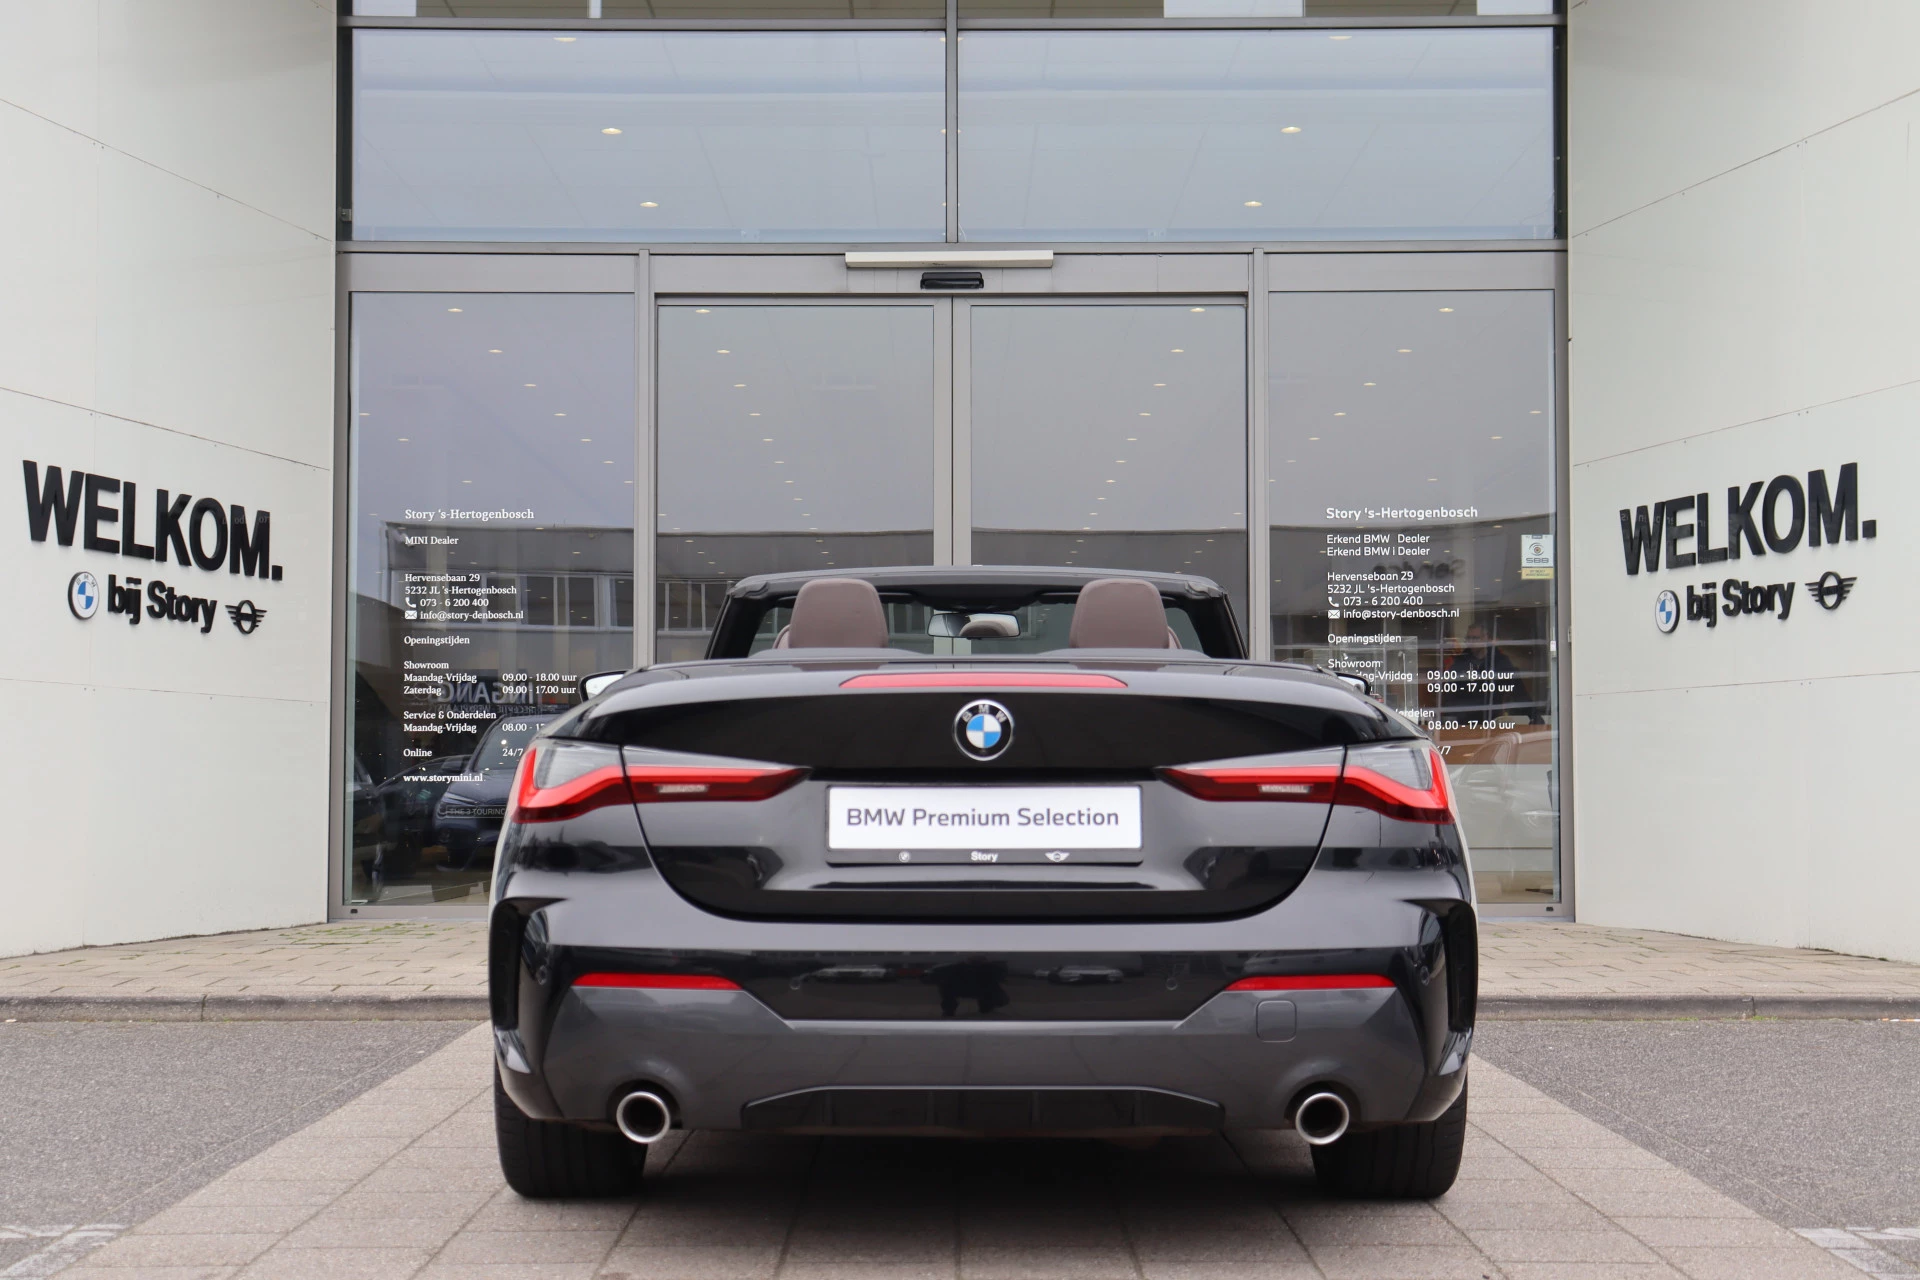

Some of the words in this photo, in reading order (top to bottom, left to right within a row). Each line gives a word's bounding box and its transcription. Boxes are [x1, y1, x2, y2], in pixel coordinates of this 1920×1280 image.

[405, 509, 435, 522] Story
[1326, 507, 1362, 521] Story
[1619, 462, 1877, 576] WELKOM.
[23, 460, 283, 581] WELKOM.
[405, 536, 428, 545] MINI
[430, 536, 459, 545] Dealer
[1327, 534, 1361, 544] Erkend
[1363, 534, 1390, 543] BMW
[1397, 534, 1430, 543] Dealer
[1327, 547, 1361, 556] Erkend
[1363, 547, 1391, 556] BMW
[1398, 547, 1430, 556] Dealer
[405, 573, 466, 582] Hervensebaan
[468, 573, 480, 582] 29
[1327, 572, 1399, 582] Hervensebaan
[1400, 571, 1414, 581] 29
[405, 586, 427, 595] 5232
[429, 586, 440, 596] JL
[1327, 584, 1352, 594] 5232
[1354, 584, 1365, 594] JL
[108, 574, 142, 625] bij
[147, 580, 217, 633] Story
[420, 598, 437, 607] 073
[445, 598, 451, 607] 6
[453, 598, 470, 607] 200
[472, 598, 489, 607] 400
[1343, 597, 1362, 606] 073
[1371, 597, 1378, 606] 6
[1380, 596, 1400, 606] 200
[1402, 596, 1423, 606] 400
[1686, 582, 1717, 627] bij
[1721, 579, 1795, 620] Story
[420, 610, 524, 621] info@story-denbosch.nl
[1343, 608, 1460, 620] info@story-denbosch.nl
[404, 636, 470, 646] Openingstijden
[1327, 634, 1402, 645] Openingstijden
[404, 661, 449, 669] Showroom
[1328, 659, 1381, 668] Showroom
[404, 673, 477, 683] Maandag-Vrijdag
[502, 673, 528, 682] 09.00
[535, 673, 560, 682] 18.00
[1427, 670, 1458, 680] 09.00
[1466, 670, 1495, 680] 18.00
[1497, 672, 1514, 680] uur
[404, 686, 442, 696] Zaterdag
[502, 686, 528, 694] 09.00
[535, 686, 559, 694] 17.00
[1427, 683, 1458, 693] 09.00
[404, 711, 436, 720] Service
[438, 711, 445, 720] &
[446, 711, 497, 720] Onderdelen
[962, 704, 1007, 722] BMW
[403, 723, 477, 734] Maandag-Vrijdag
[502, 723, 527, 732] 08.00
[1428, 720, 1459, 730] 08.00
[1499, 722, 1515, 730] uur
[403, 748, 432, 757] Online
[502, 748, 524, 758] 24/7
[403, 774, 483, 783] www.storymini.nl
[847, 809, 905, 826] BMW
[912, 809, 1010, 826] Premium
[1017, 808, 1119, 826] Selection
[971, 852, 998, 862] Story
